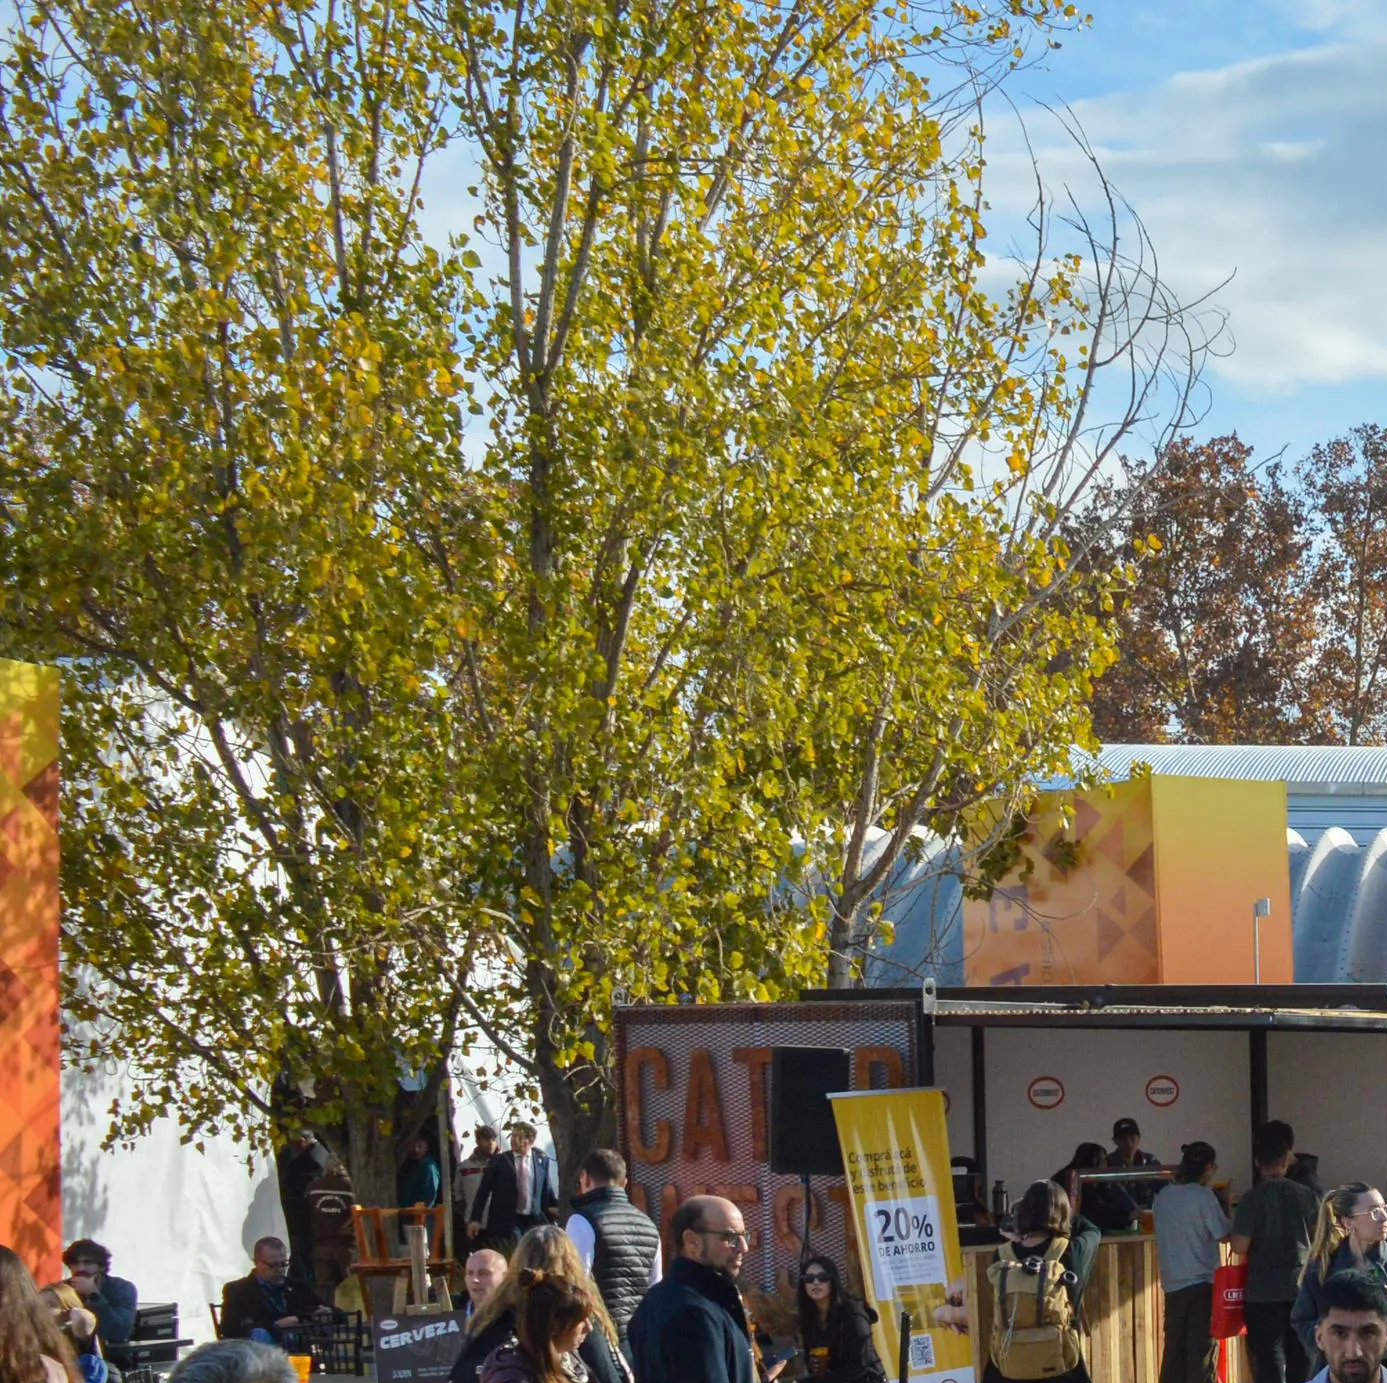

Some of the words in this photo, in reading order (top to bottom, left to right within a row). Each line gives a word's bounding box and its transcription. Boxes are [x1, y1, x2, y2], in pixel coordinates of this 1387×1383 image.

[625, 1045, 907, 1166] CAT
[902, 1164, 917, 1175] de
[875, 1206, 934, 1244] 20%
[878, 1246, 891, 1257] DE
[893, 1240, 936, 1256] AHORRO
[380, 1319, 461, 1350] CERVEZA
